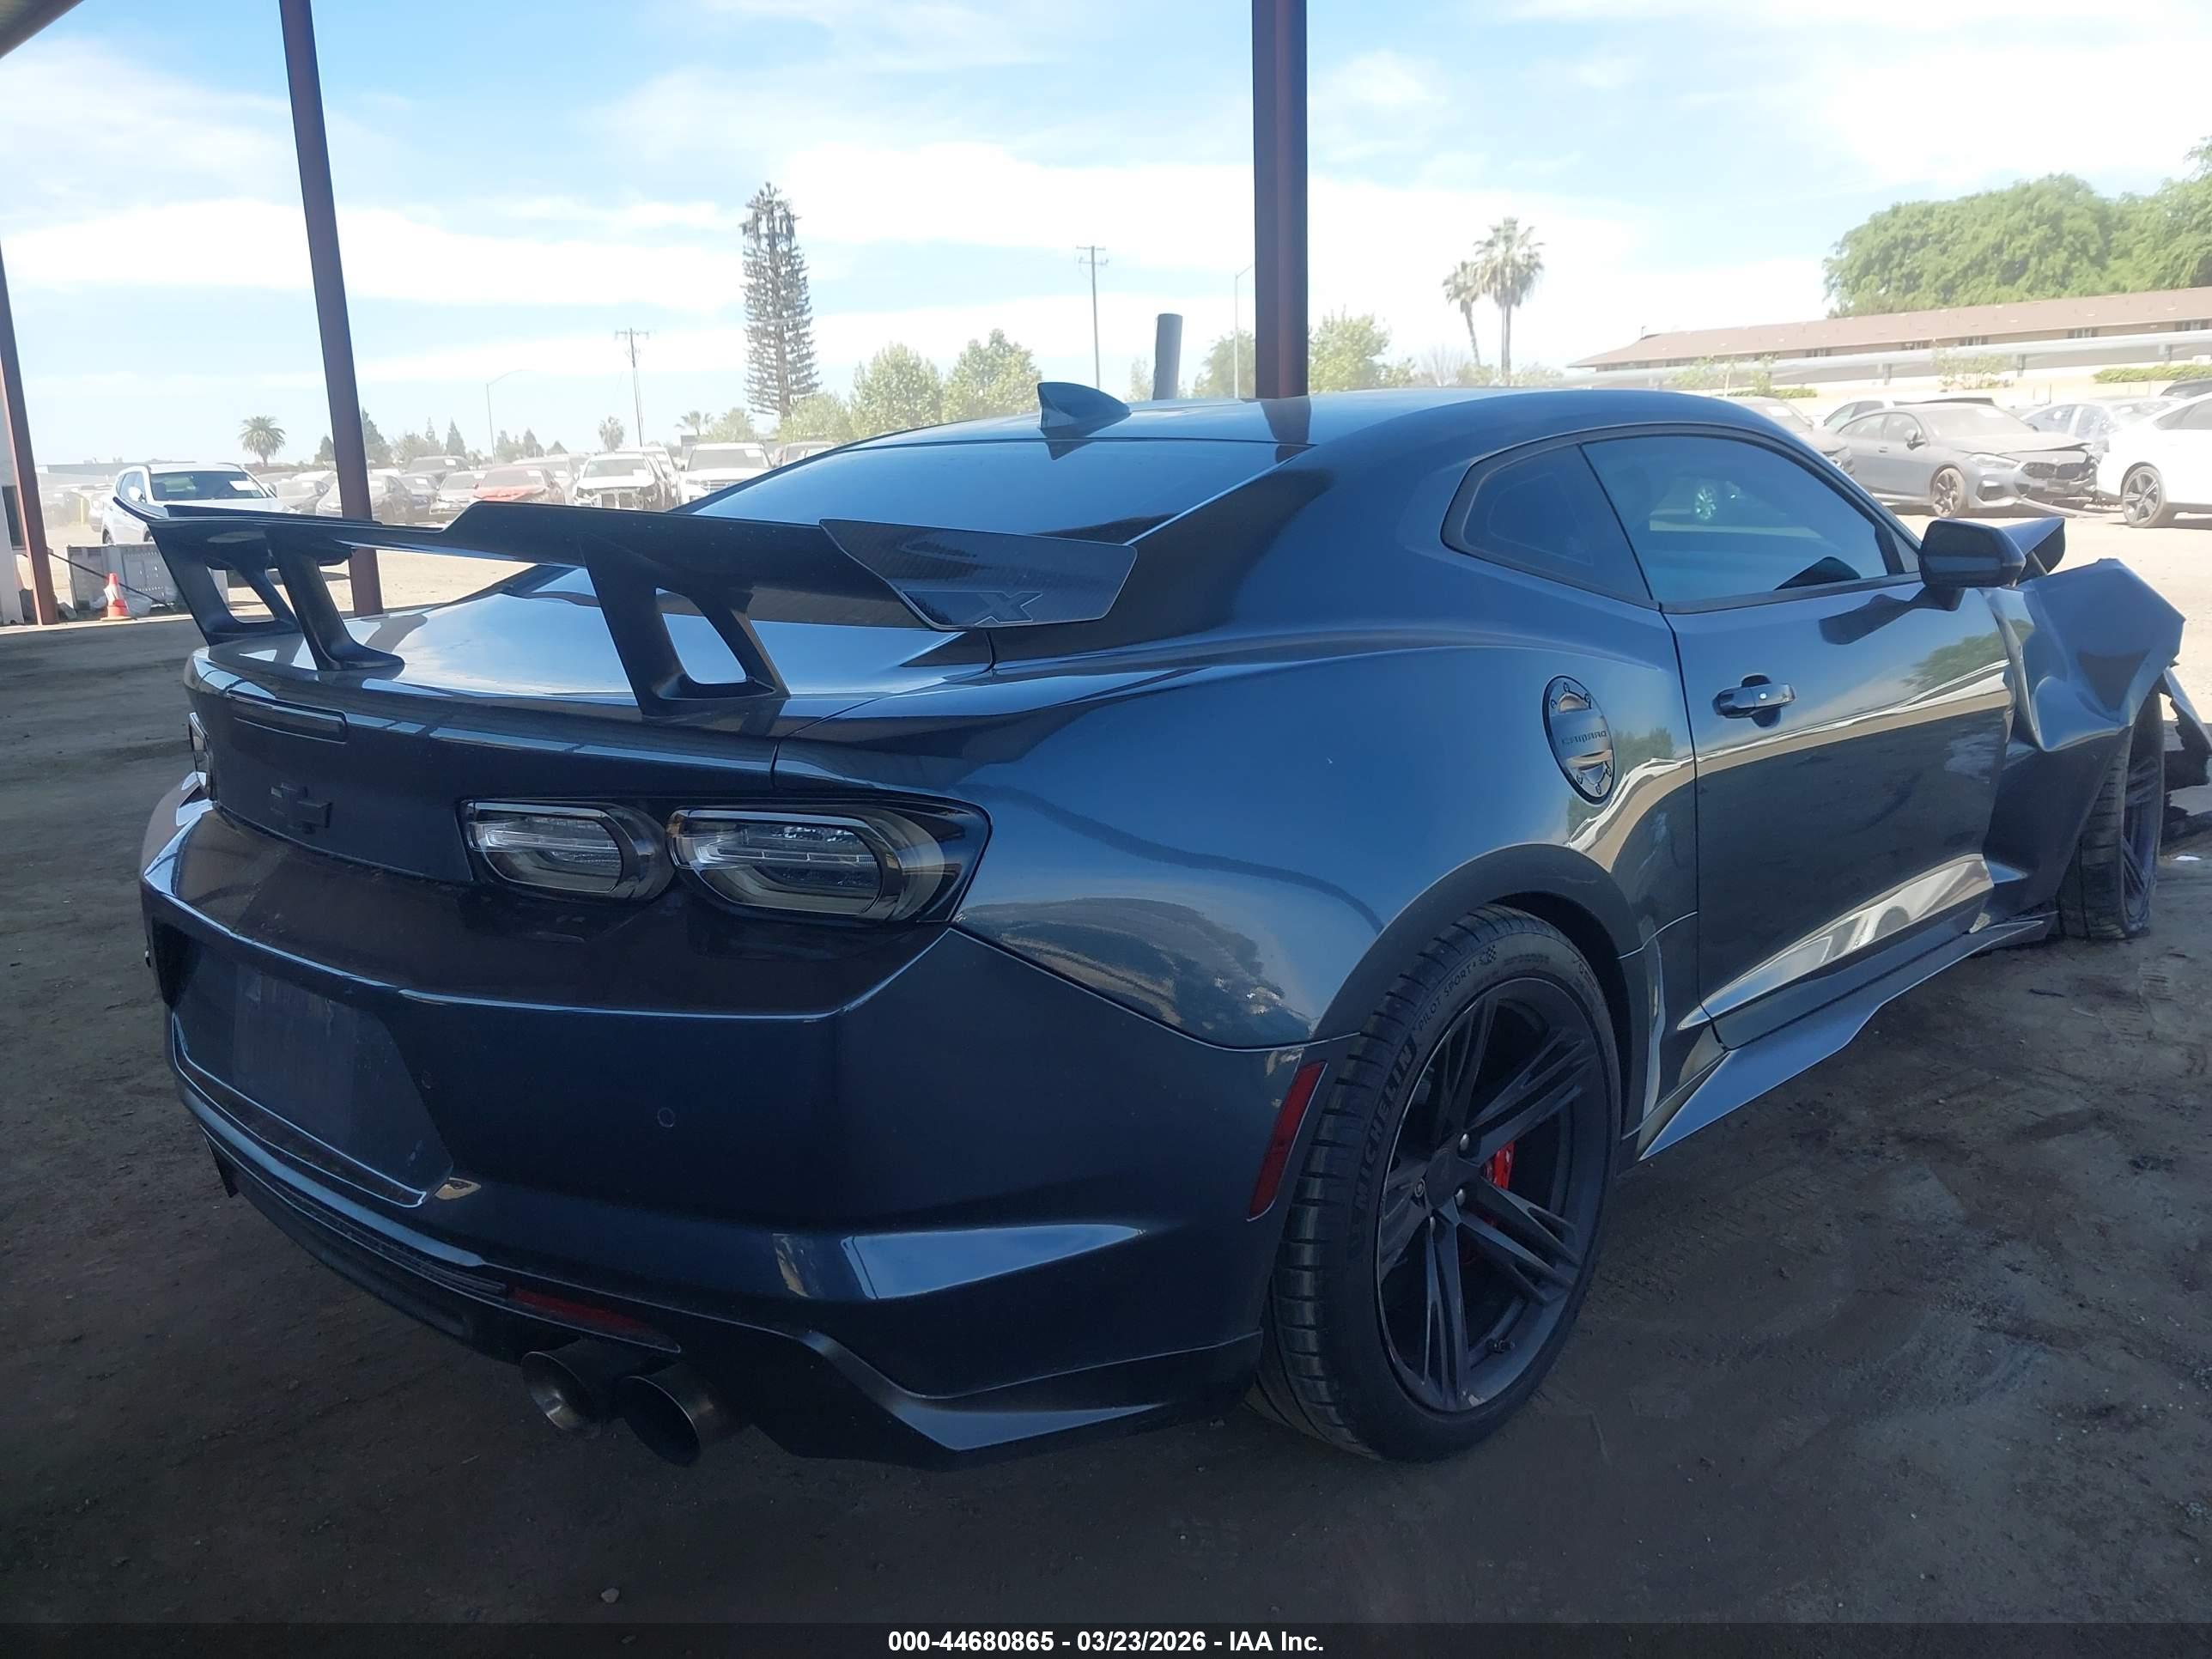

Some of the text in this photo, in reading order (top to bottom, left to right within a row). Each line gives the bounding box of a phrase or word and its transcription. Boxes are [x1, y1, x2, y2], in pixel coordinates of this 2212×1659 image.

[1419, 963, 1472, 1031] PILOT SPORT
[1354, 1042, 1414, 1210] MICHELIN
